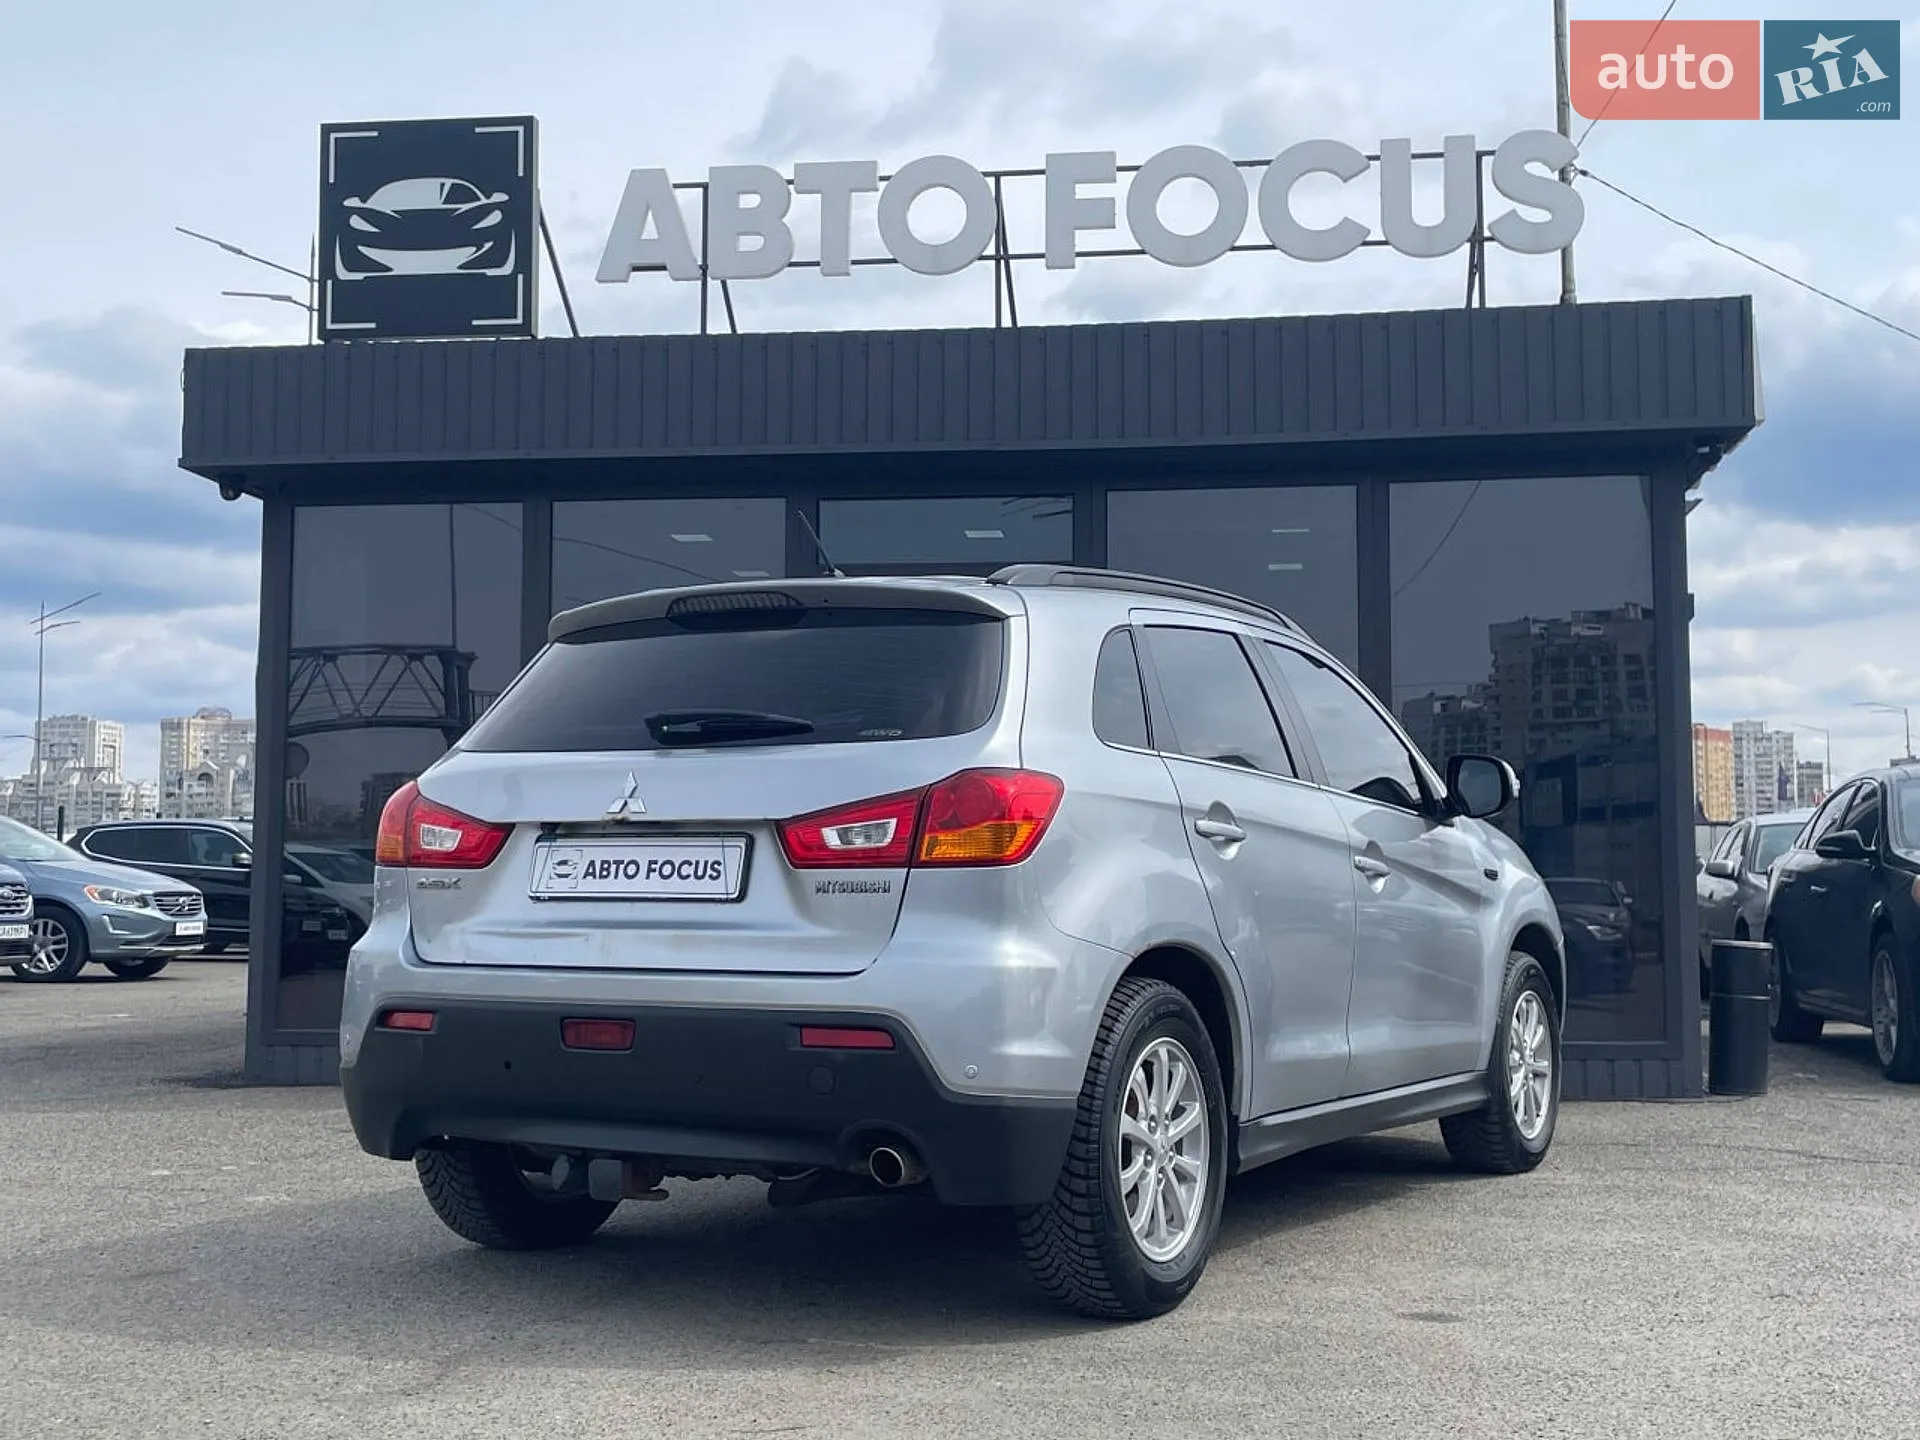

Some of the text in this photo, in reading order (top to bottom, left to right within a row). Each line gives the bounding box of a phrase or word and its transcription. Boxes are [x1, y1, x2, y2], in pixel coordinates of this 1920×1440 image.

[1044, 129, 1585, 270] FOCUS
[645, 859, 722, 881] FOCUS
[814, 880, 891, 894] MITSUBISHI
